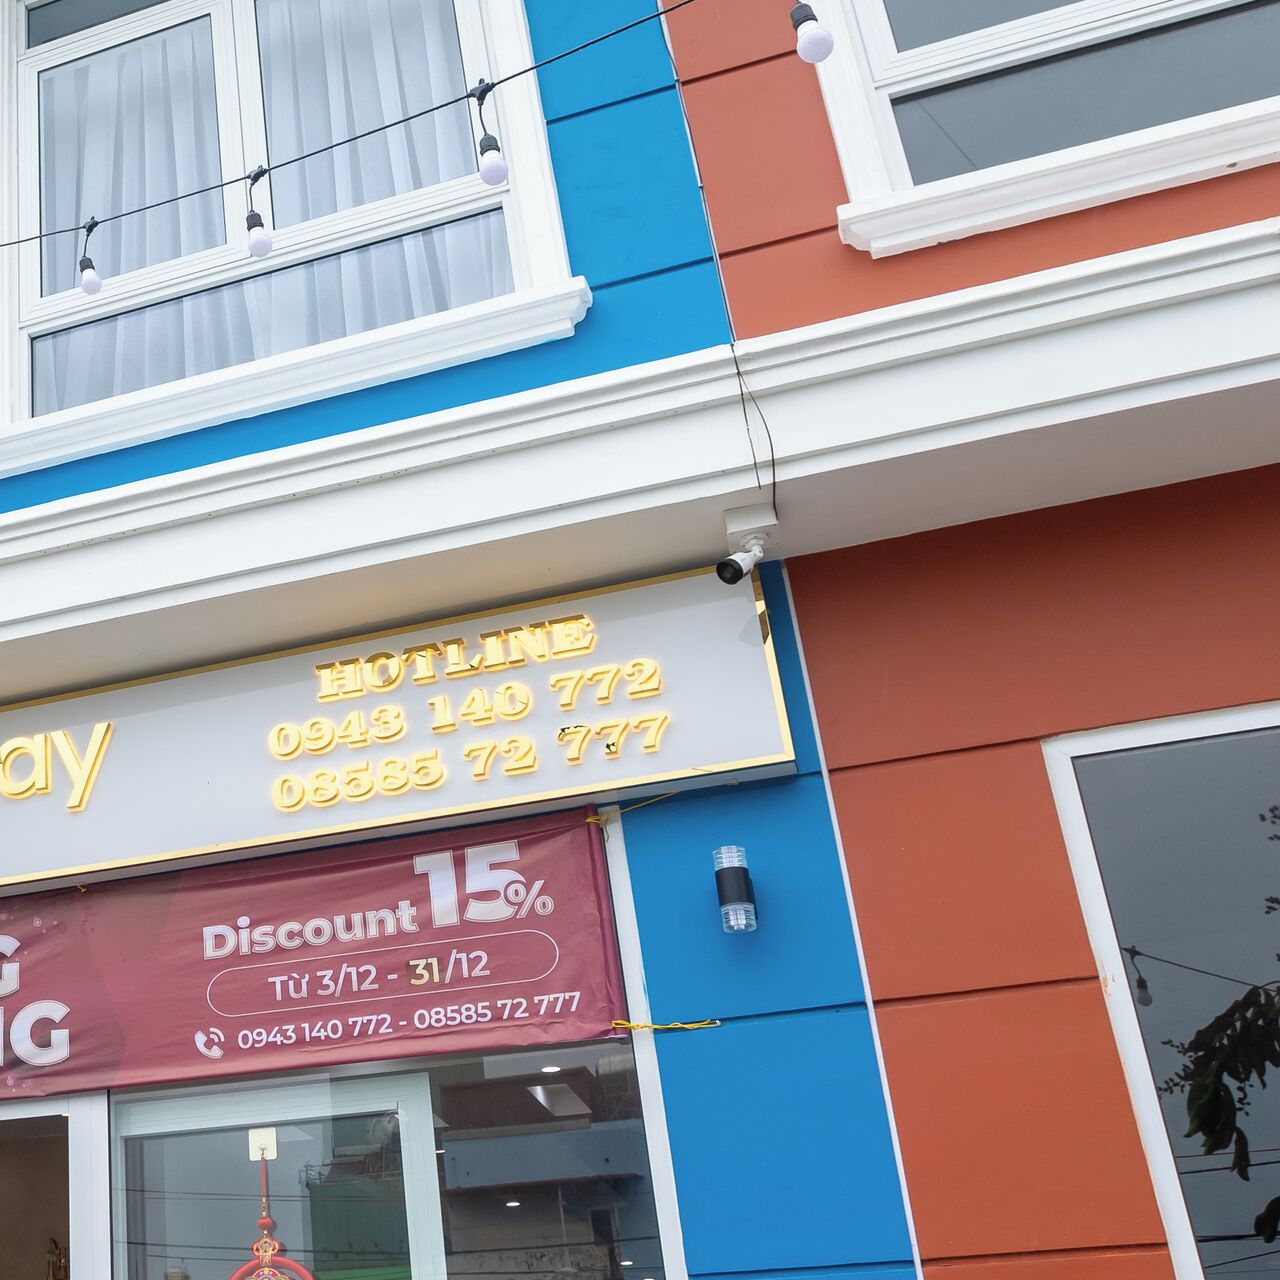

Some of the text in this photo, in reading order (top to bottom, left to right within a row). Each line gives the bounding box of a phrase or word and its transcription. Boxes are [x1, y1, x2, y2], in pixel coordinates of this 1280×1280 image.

[315, 613, 595, 701] HOTLINE
[269, 657, 663, 760] 0943 140 772
[272, 713, 670, 812] 08585 72 777
[202, 839, 556, 961] Discount 15%
[236, 1025, 297, 1050] 0943
[304, 1019, 343, 1043] 140
[348, 1013, 393, 1037] 772
[413, 1001, 493, 1030] 08585
[496, 997, 529, 1020] 72
[533, 991, 582, 1016] 777
[267, 972, 310, 1002] Từ
[316, 963, 379, 998] 3/12
[408, 949, 491, 987] 31/12
